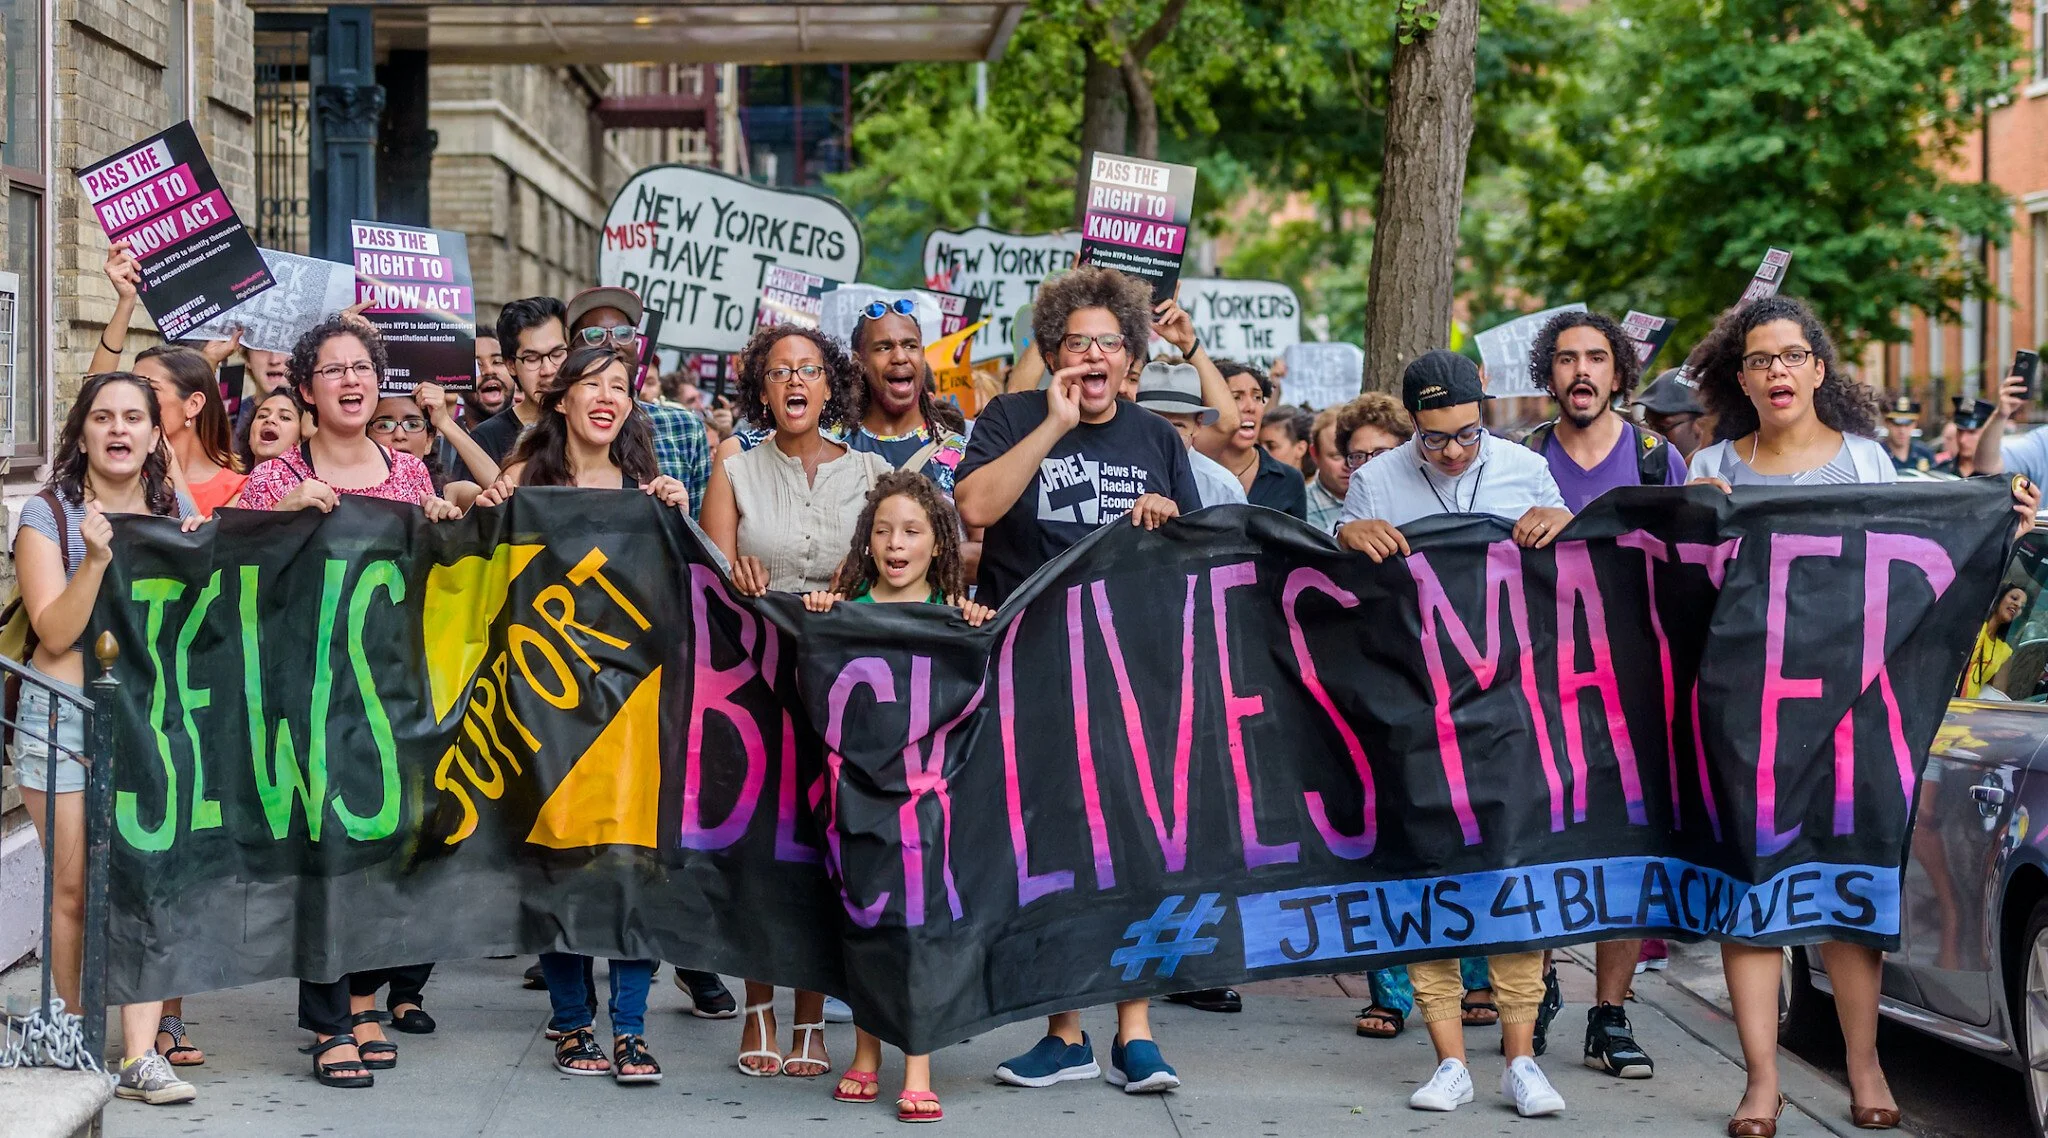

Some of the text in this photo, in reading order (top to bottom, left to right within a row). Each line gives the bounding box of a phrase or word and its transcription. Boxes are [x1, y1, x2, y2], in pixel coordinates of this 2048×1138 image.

[86, 147, 161, 197] PASS THE
[1097, 160, 1159, 187] PASS THE
[101, 172, 188, 231] RIGHT TO
[180, 196, 220, 234] ACT
[1092, 186, 1167, 218] RIGHT TO
[604, 221, 658, 251] MUST
[633, 184, 846, 261] NEW YORKERS
[1088, 215, 1178, 250] KNOW ACT
[358, 227, 428, 251] PASS THE
[164, 252, 181, 267] NYPD
[360, 252, 443, 279] RIGHT TO
[650, 234, 729, 281] HAVE
[936, 242, 984, 274] NEW
[425, 286, 461, 310] ACT
[621, 271, 706, 325] RIGHT
[713, 293, 743, 332] TO
[962, 280, 1005, 307] AVE
[1203, 291, 1294, 319] YORKERS
[157, 294, 206, 326] COMMUNITIES
[192, 303, 221, 324] REFORM
[1240, 324, 1275, 350] THE
[1041, 452, 1090, 493] JFREJ
[1100, 462, 1148, 481] Jews For
[1101, 478, 1146, 494] Racial &
[1101, 494, 1136, 508] Econo
[115, 558, 405, 852] JEWS
[435, 546, 652, 846] SUPPORT
[681, 529, 1957, 928] BLCK LIVES MATTER
